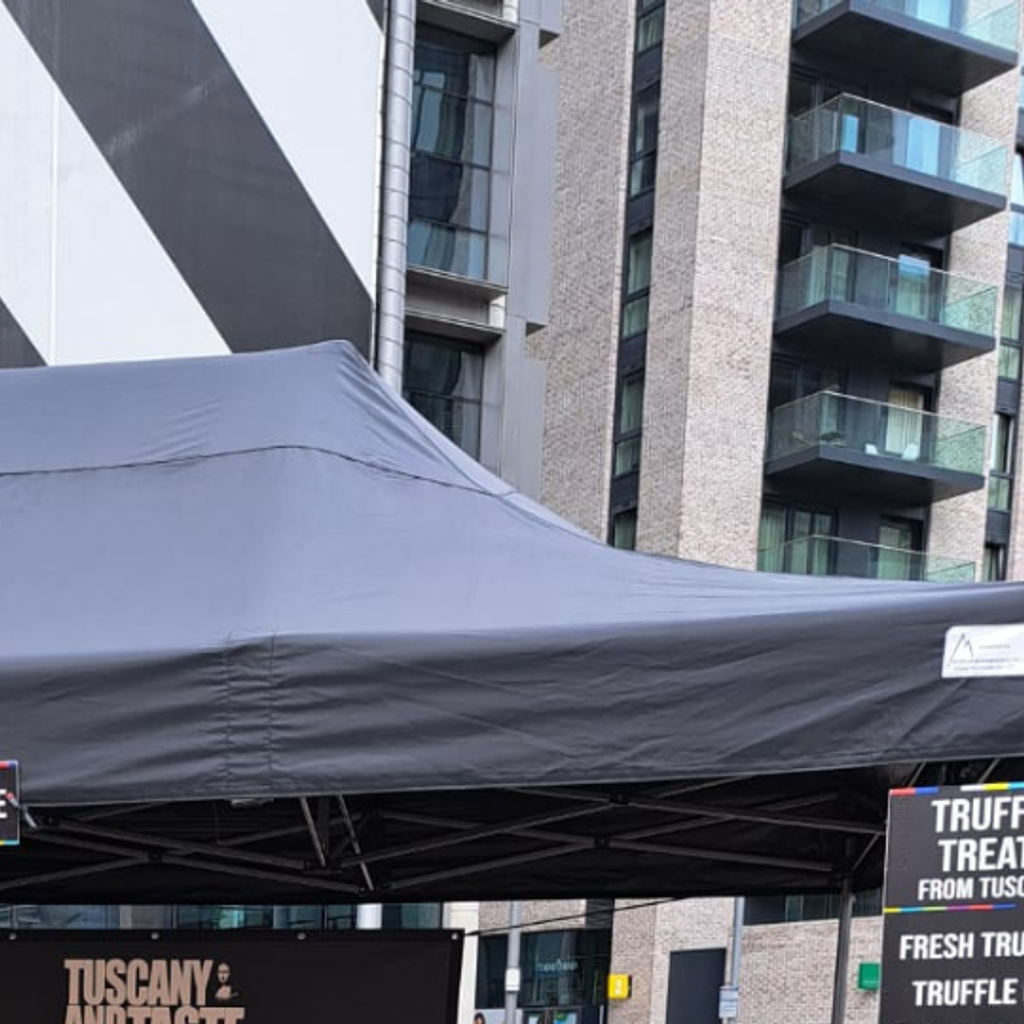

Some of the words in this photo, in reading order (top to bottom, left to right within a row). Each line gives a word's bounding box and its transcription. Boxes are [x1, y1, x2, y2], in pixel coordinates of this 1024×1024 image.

[918, 877, 974, 900] FROM
[899, 932, 975, 960] FRESH
[64, 958, 214, 1007] TUSCANY
[912, 978, 1019, 1006] TRUFFLE
